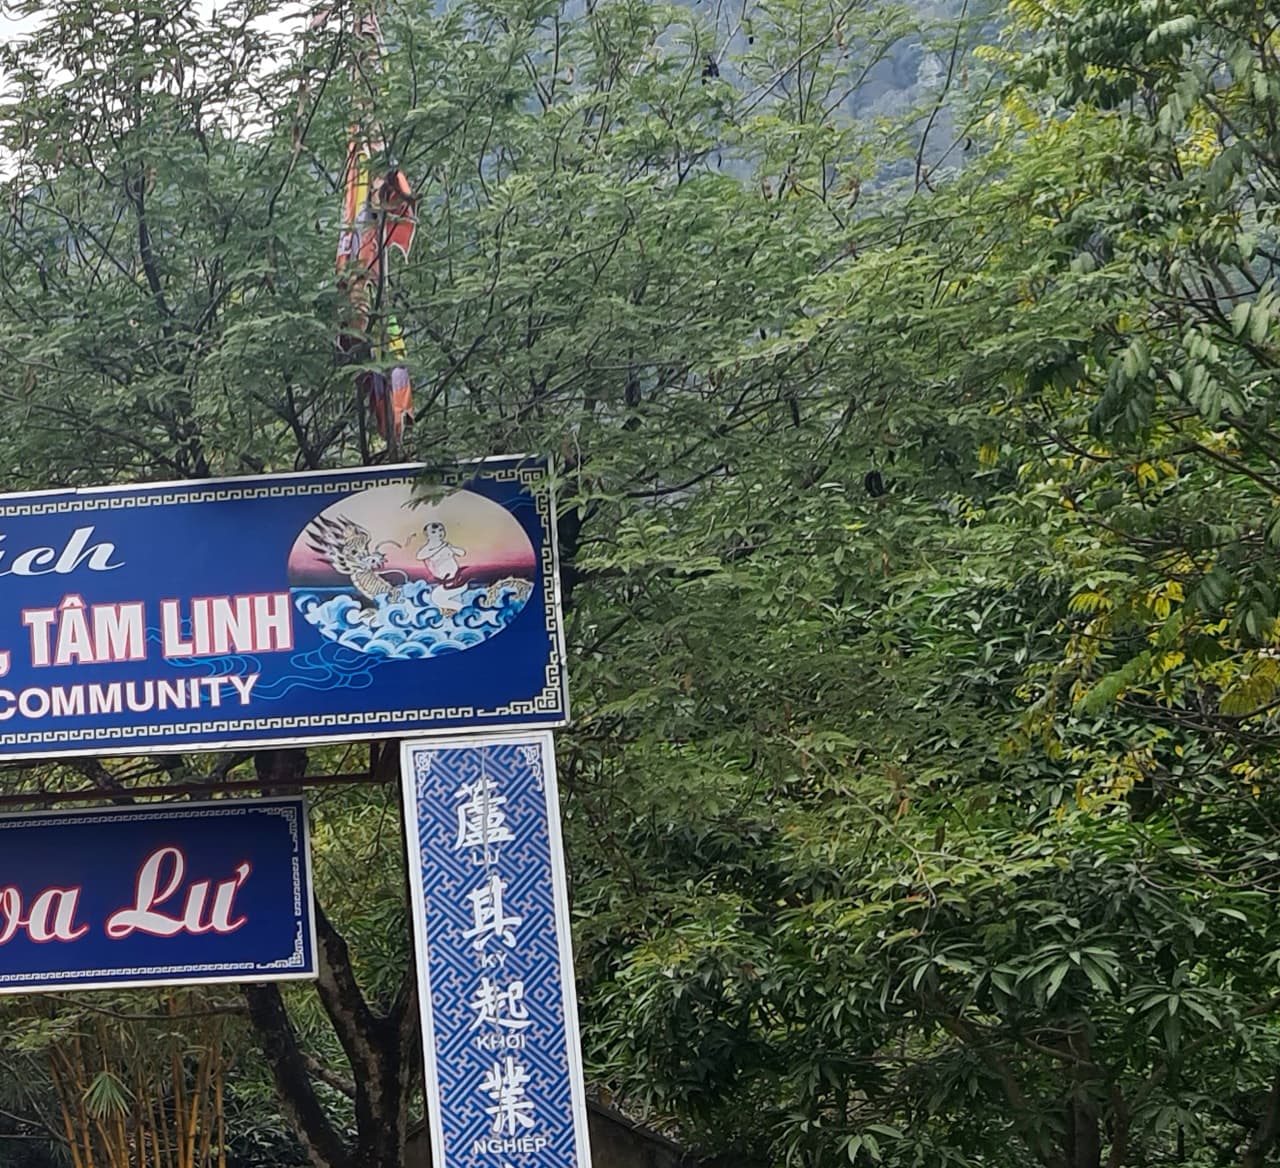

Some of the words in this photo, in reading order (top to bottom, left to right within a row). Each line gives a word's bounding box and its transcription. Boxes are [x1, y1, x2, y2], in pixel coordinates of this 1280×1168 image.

[22, 593, 146, 668] TÂM
[160, 591, 294, 660] LINH
[106, 846, 253, 939] Lư
[472, 1135, 548, 1156] NGHIỆP
